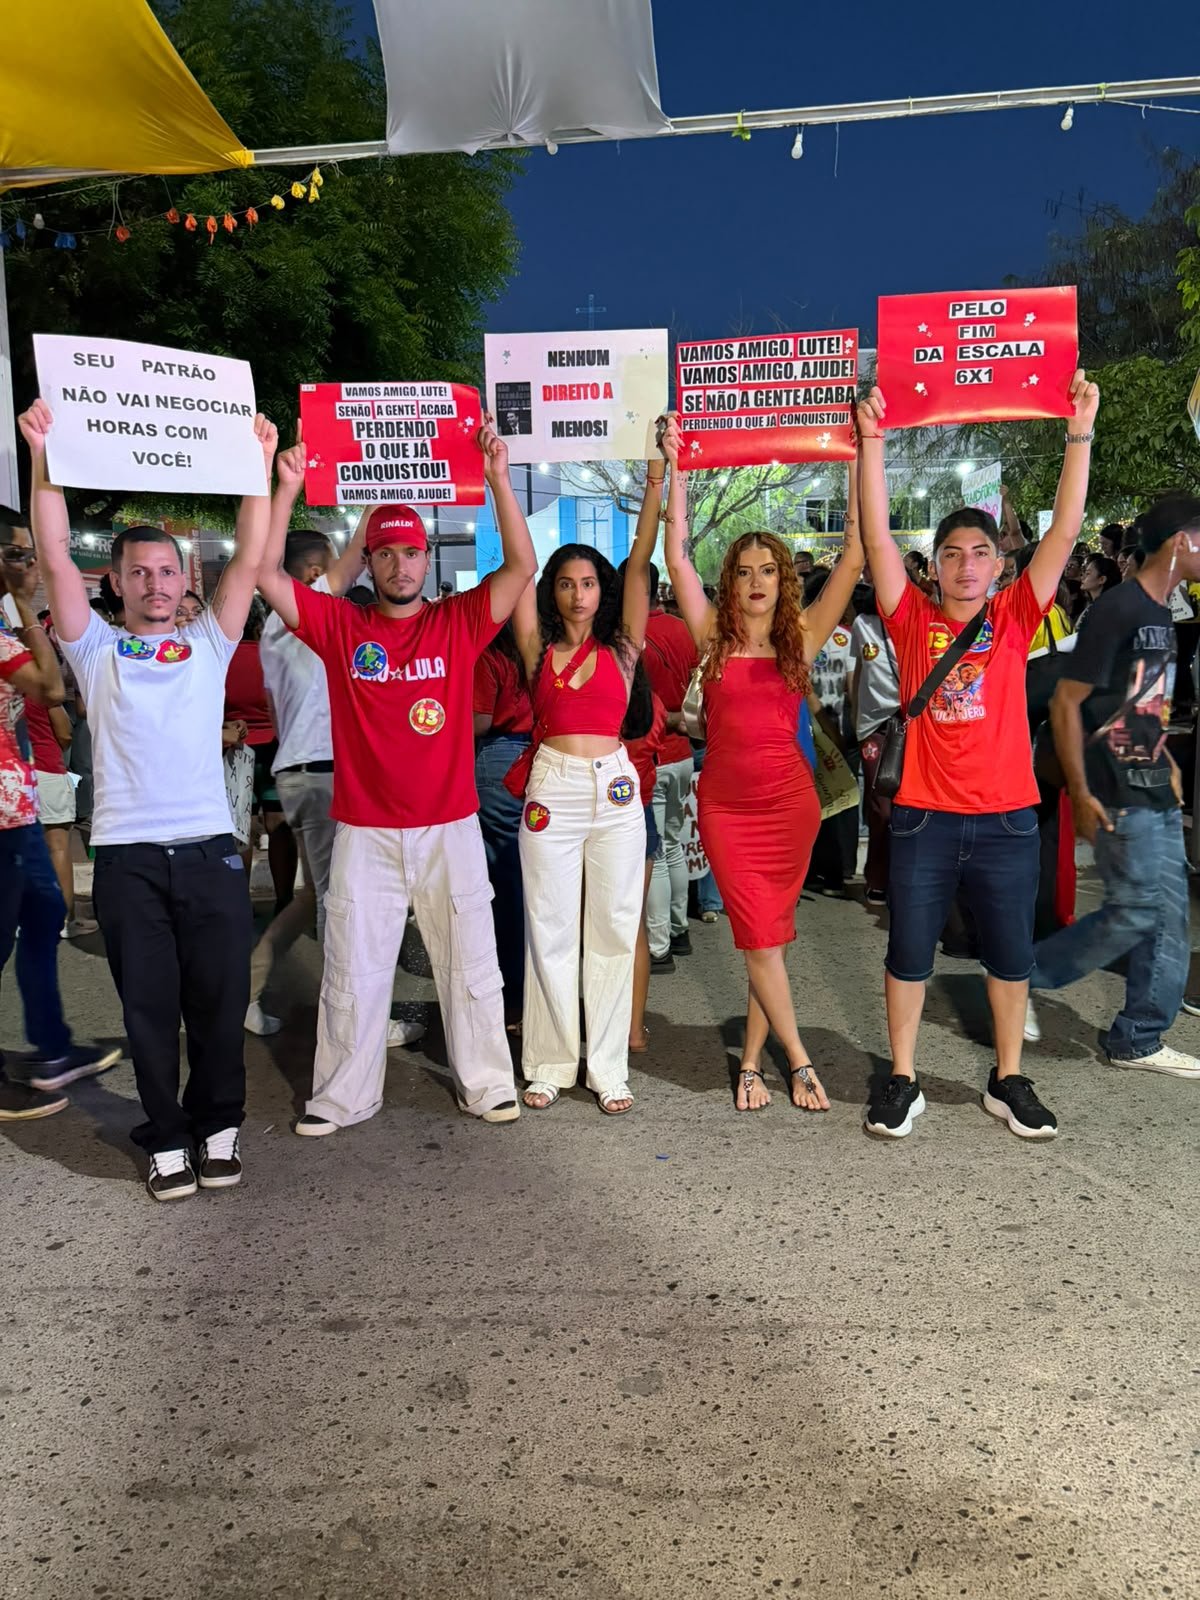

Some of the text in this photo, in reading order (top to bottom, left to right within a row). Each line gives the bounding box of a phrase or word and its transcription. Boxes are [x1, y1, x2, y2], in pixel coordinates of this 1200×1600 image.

[951, 301, 1005, 317] PELO
[959, 325, 995, 338] FIM
[548, 350, 610, 367] NENHUM
[680, 337, 841, 362] VAMOS AMIGO, LUTE!
[915, 342, 1042, 362] DA ESCALA
[73, 352, 216, 381] SEU PATRÃO
[683, 360, 854, 385] VAMOS AMIGO, AJUDE!
[956, 369, 993, 384] 6X1
[345, 385, 447, 398] VAMOS AMIGO, LUTE!
[542, 382, 613, 401] DIREITO A
[685, 386, 857, 412] SE NÃO A GENTE ACABA
[62, 386, 252, 418] NÃO VAI NEGOCIAR
[339, 404, 454, 417] SENÃO A GENTE ACABA
[87, 419, 208, 441] HORAS COM
[355, 420, 436, 439] PERDENDO
[551, 420, 608, 438] MENOS!
[683, 412, 849, 431] PERDENDO O QUE JÁ CONQUISTOU!
[133, 451, 192, 468] VOCÊ!
[365, 440, 430, 460] O QUE JÁ
[340, 463, 447, 482] CONQUISTOU!
[342, 488, 451, 501] VAMOS AMIGO, AJUDE!
[405, 656, 446, 681] LULA
[416, 707, 439, 725] 13
[613, 784, 631, 798] 13
